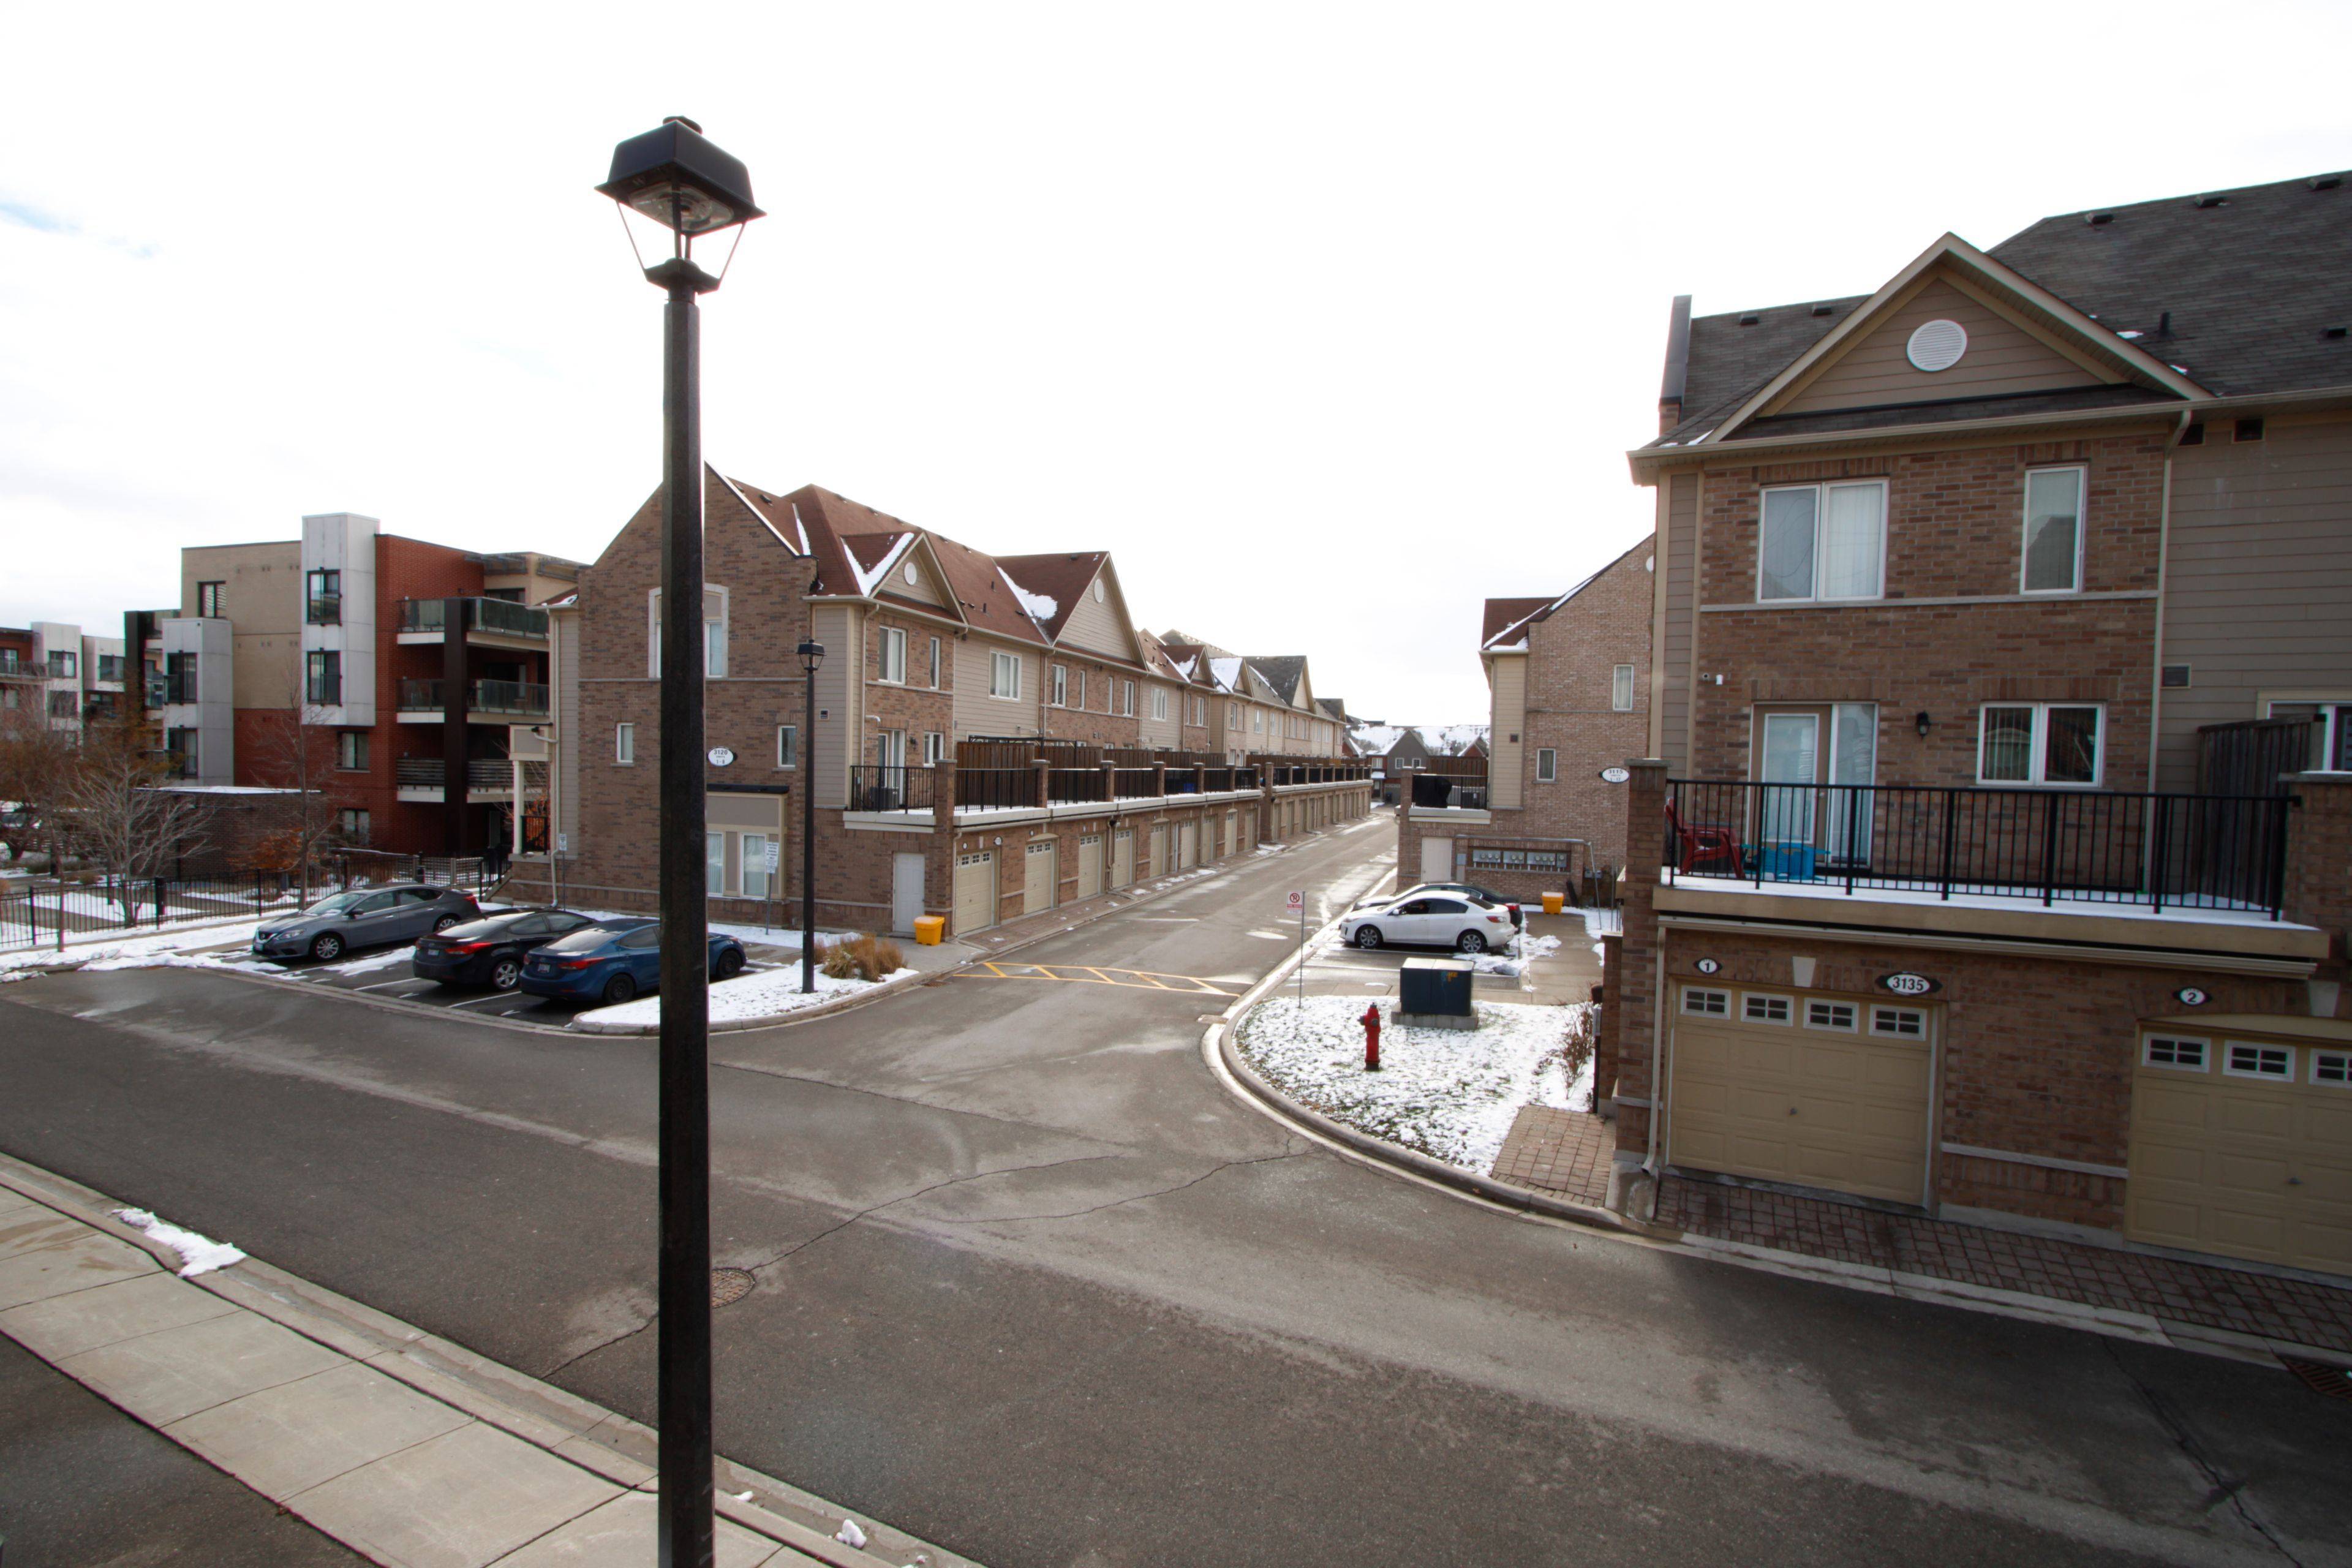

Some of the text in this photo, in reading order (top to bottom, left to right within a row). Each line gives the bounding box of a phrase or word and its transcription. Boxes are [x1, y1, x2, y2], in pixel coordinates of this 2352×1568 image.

[1705, 962, 1709, 971] 1
[1893, 976, 1924, 991] 3135
[2187, 992, 2196, 1003] 2
